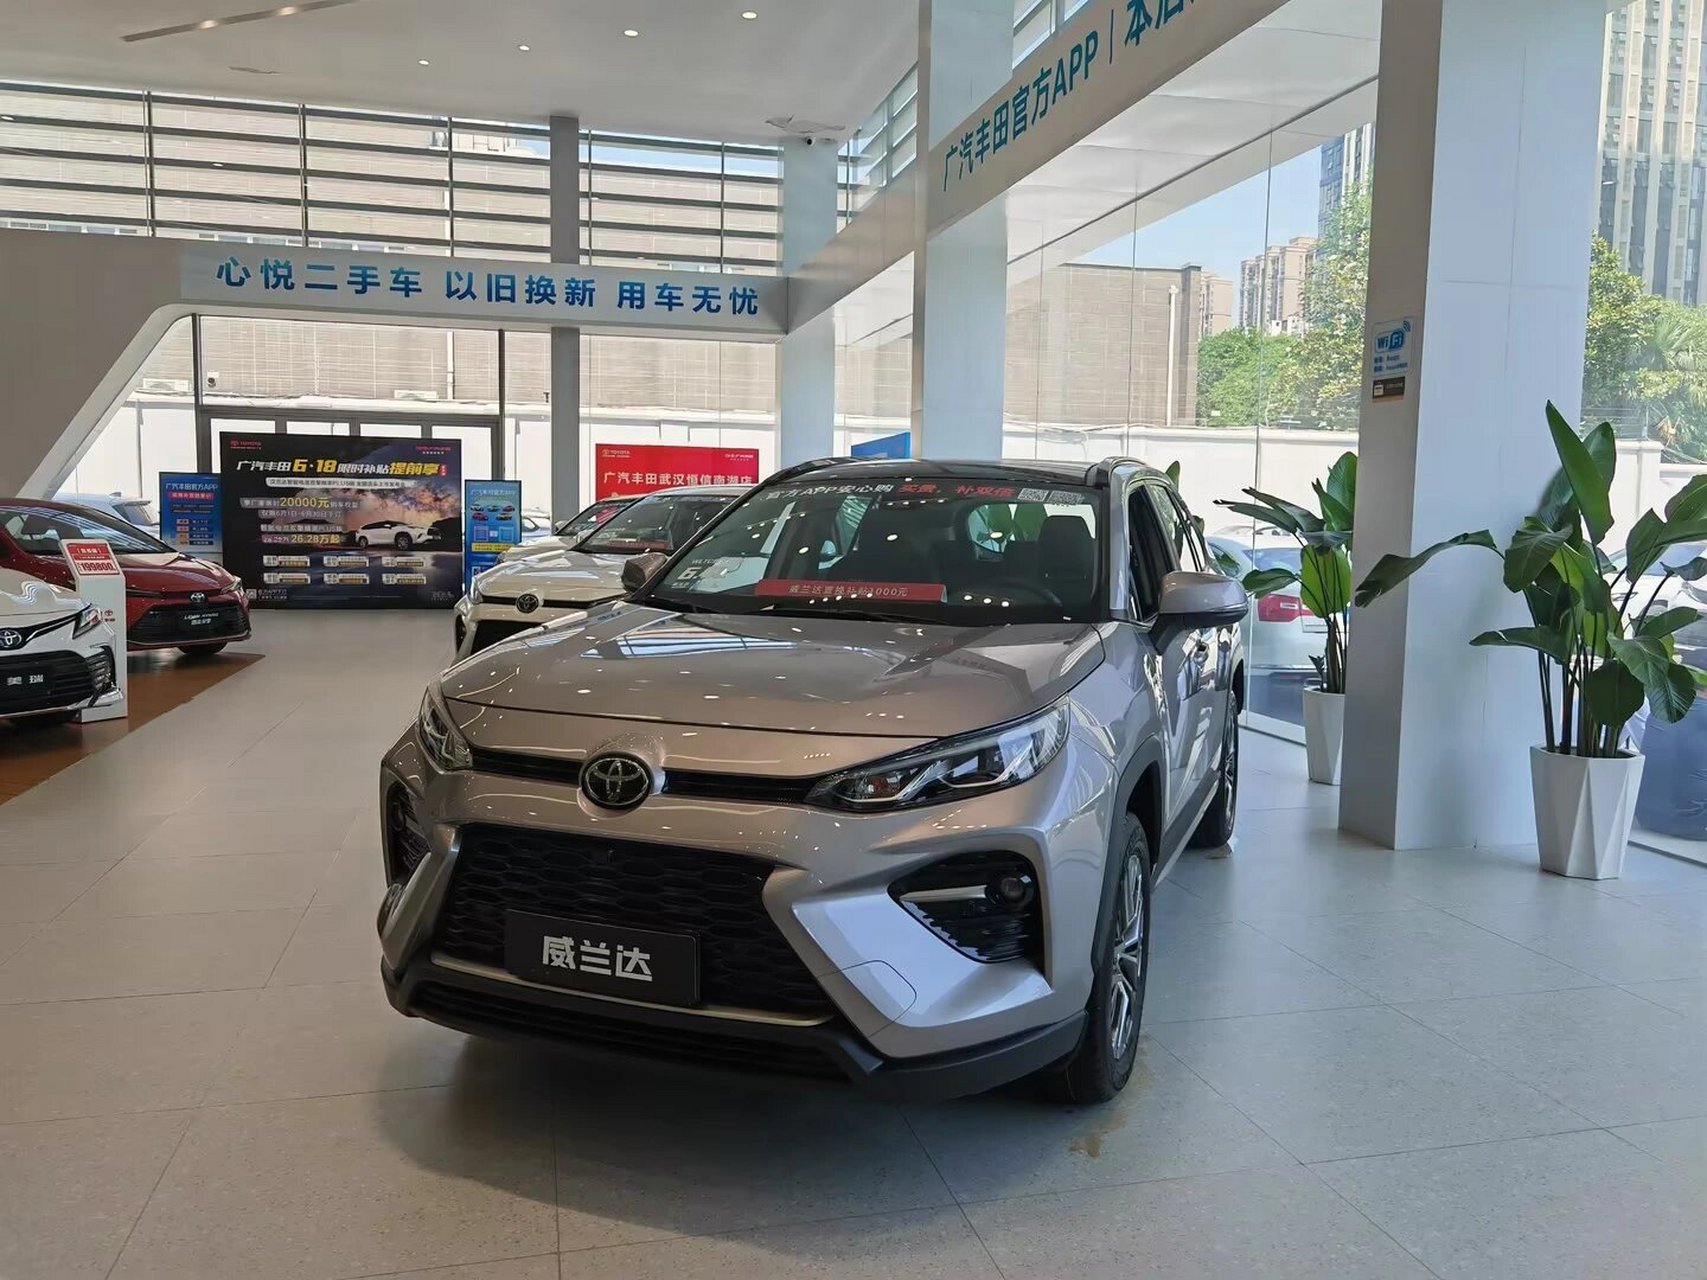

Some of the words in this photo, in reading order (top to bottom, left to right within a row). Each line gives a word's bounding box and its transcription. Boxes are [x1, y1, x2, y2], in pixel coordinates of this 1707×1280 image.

[943, 30, 1099, 192] 广汽丰田官方APP
[216, 256, 423, 298] 心悦二手车
[445, 270, 597, 309] 以旧换新
[616, 280, 759, 316] 用车无忧
[603, 471, 753, 486] 广汽丰田武汉恒信南湖店
[291, 534, 340, 544] 26.28万起
[542, 935, 653, 982] 威兰达
